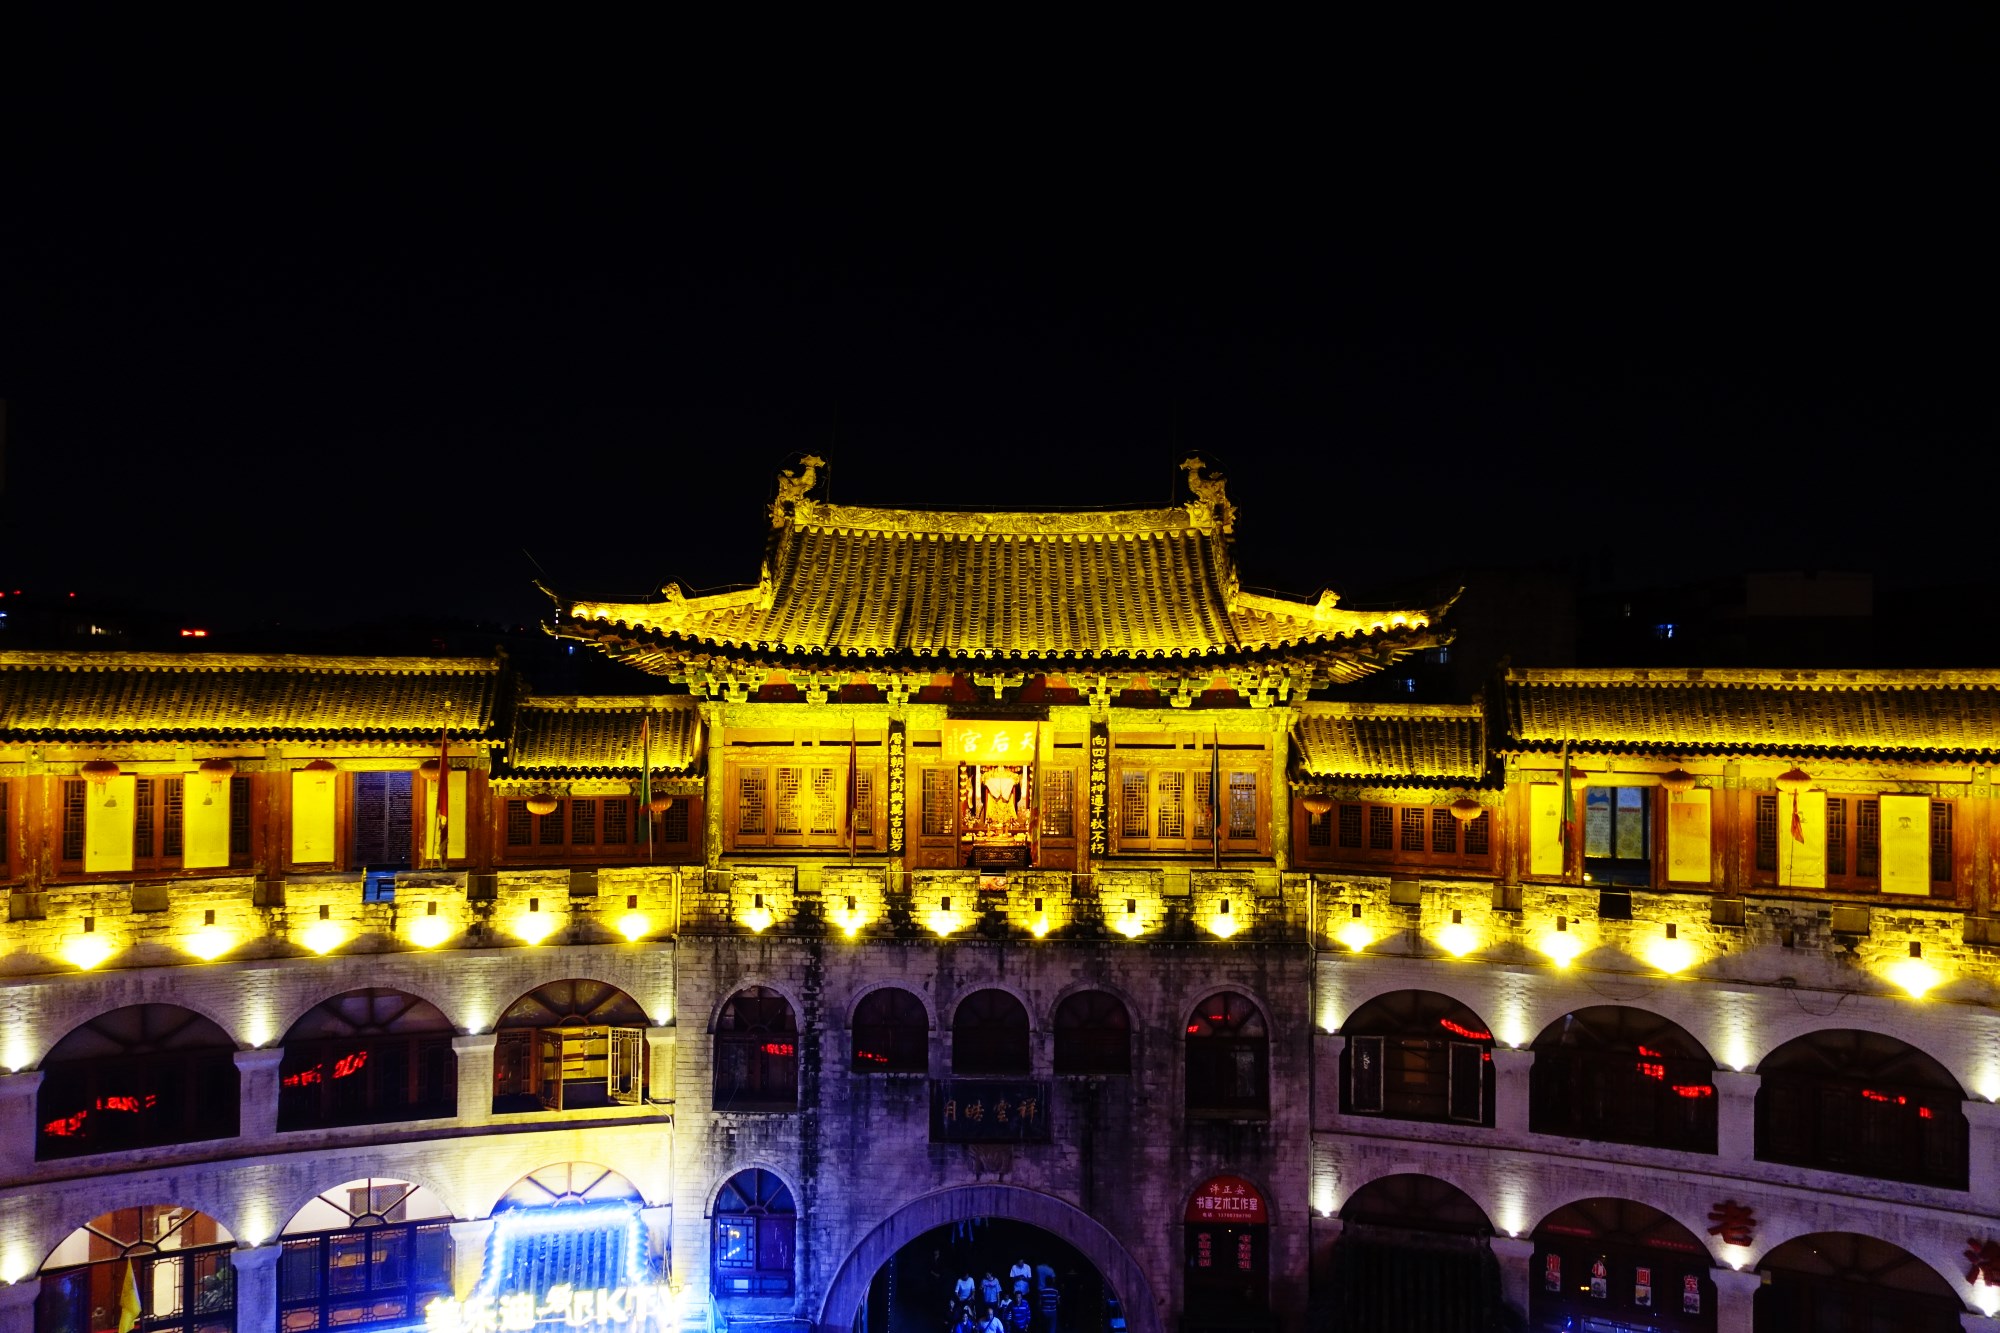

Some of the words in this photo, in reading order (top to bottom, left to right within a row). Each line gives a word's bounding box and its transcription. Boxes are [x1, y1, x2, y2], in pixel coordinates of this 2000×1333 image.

[1196, 1196, 1258, 1211] 书画艺术工作室
[1707, 1199, 1757, 1247] 老
